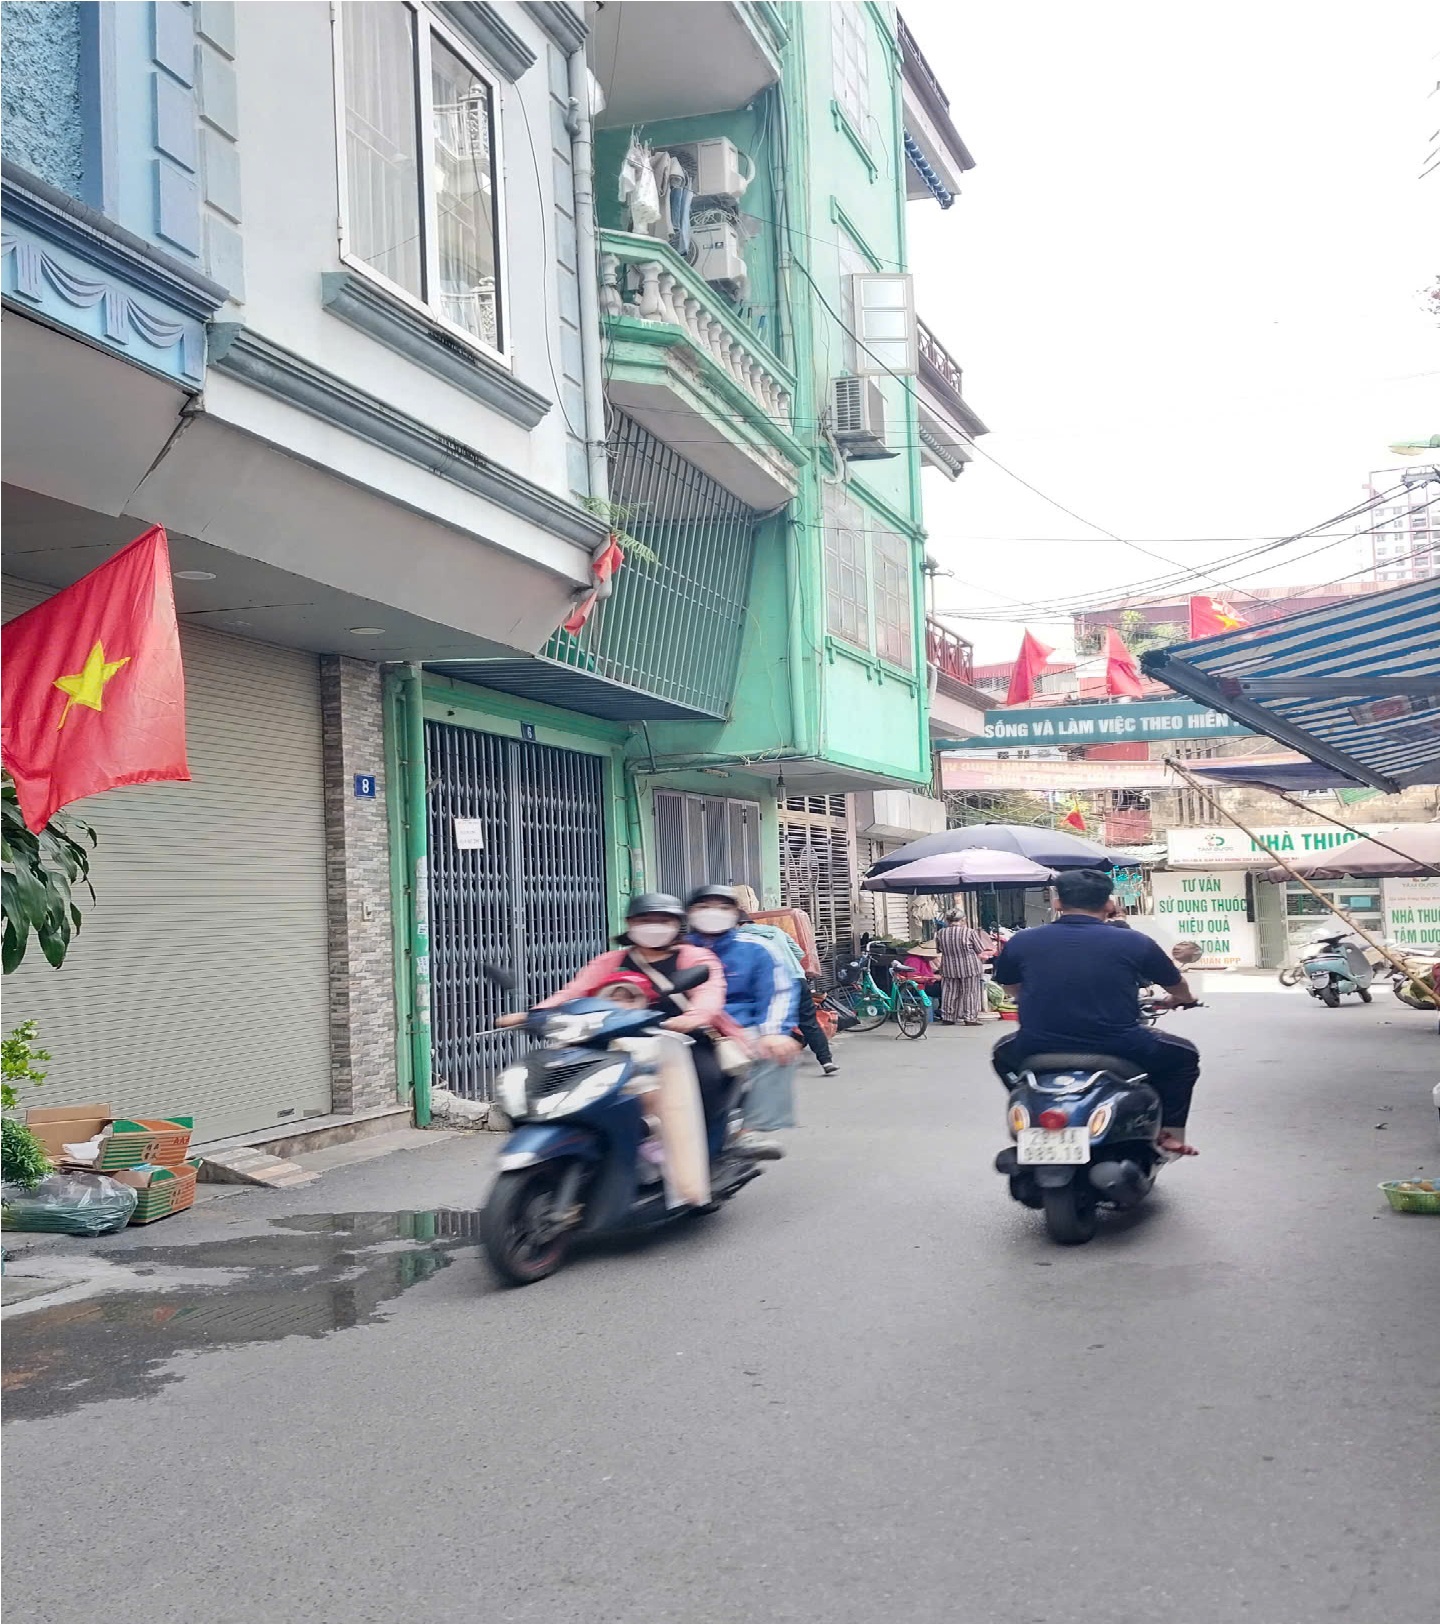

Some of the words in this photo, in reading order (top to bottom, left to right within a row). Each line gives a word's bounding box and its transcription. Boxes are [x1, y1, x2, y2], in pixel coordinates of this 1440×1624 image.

[984, 719, 1029, 739] SỐNG
[1032, 719, 1054, 736] VÀ
[1058, 717, 1094, 735] LÀM
[1098, 715, 1136, 734] VIỆC
[1139, 715, 1183, 732] THEO
[362, 778, 370, 794] 8
[1251, 829, 1295, 852] NHÀ
[1182, 877, 1196, 892] TƯ
[1199, 873, 1221, 892] VẤN
[1160, 895, 1174, 913] SỬ
[1177, 899, 1208, 915] DỤNG
[1211, 894, 1247, 912] THUỐC
[1392, 906, 1415, 923] NHÀ
[1179, 917, 1204, 935] HIỆU
[1207, 915, 1231, 933] QUẢ
[1200, 936, 1230, 953] TOÀN
[1393, 926, 1417, 944] TÂM
